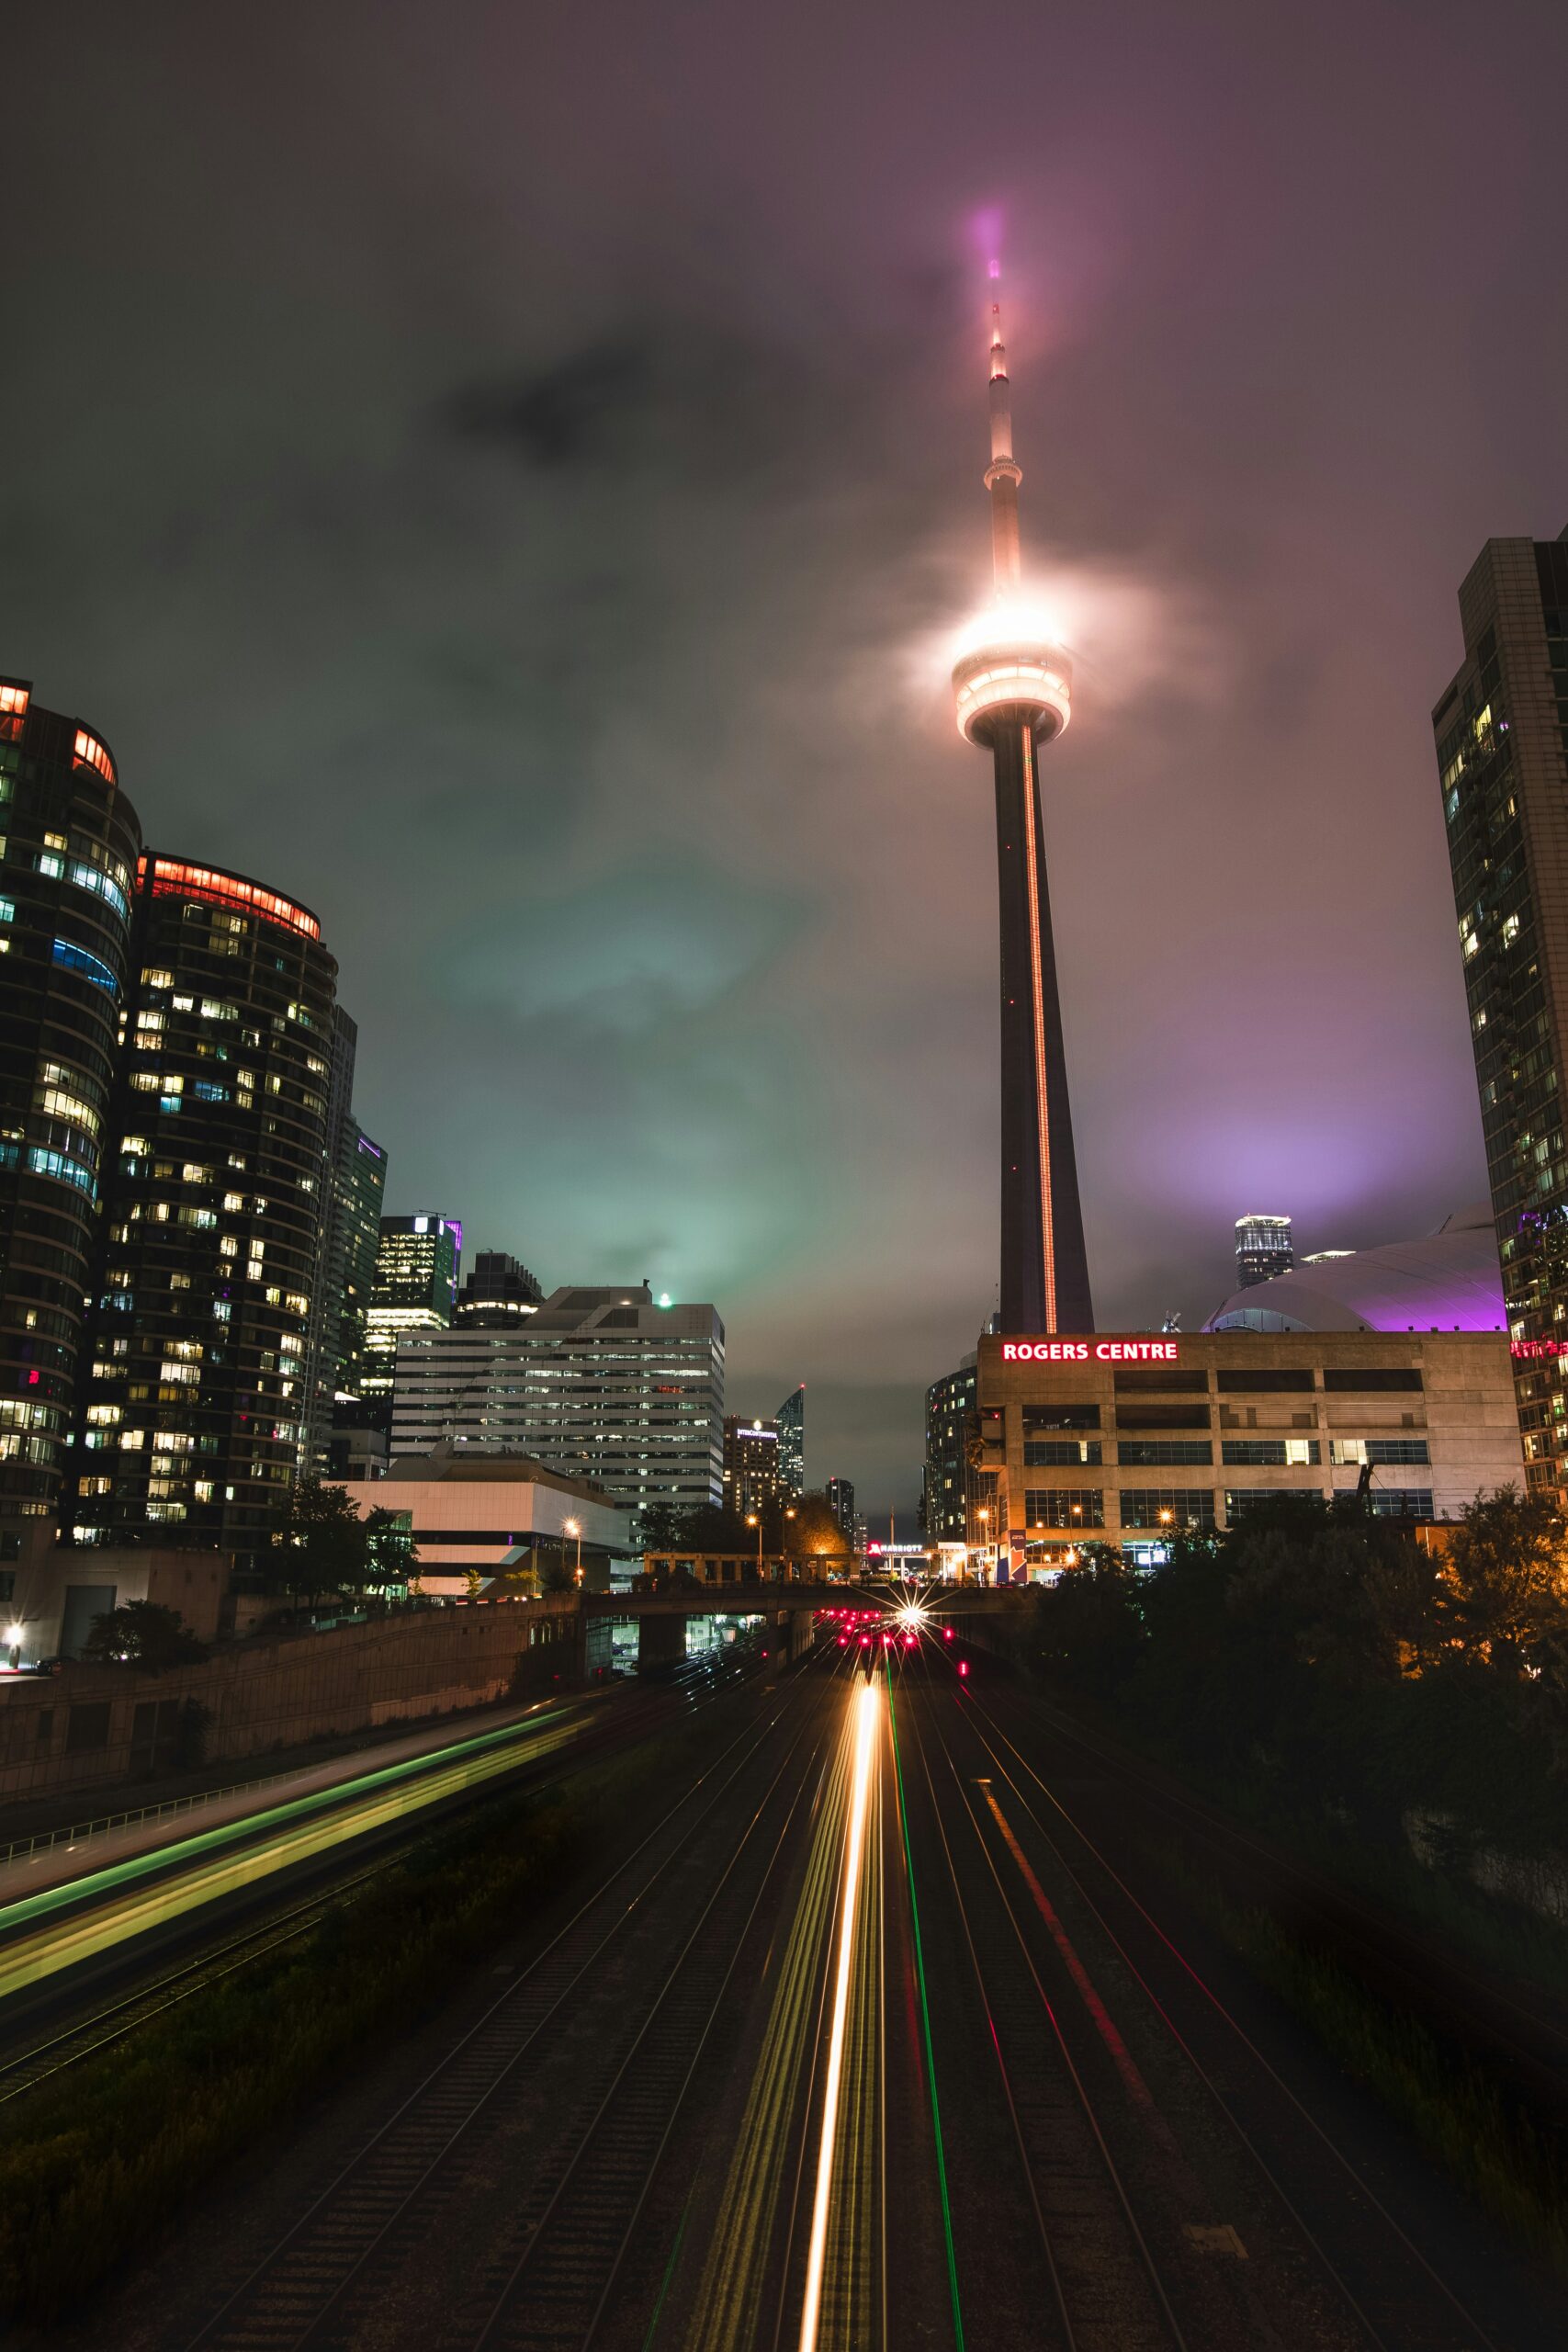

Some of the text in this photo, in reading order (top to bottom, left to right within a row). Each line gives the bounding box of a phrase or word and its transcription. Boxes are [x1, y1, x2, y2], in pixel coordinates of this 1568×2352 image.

[1003, 1343, 1178, 1360] ROGERS CENTRE
[880, 1544, 922, 1553] MARRIOTT
